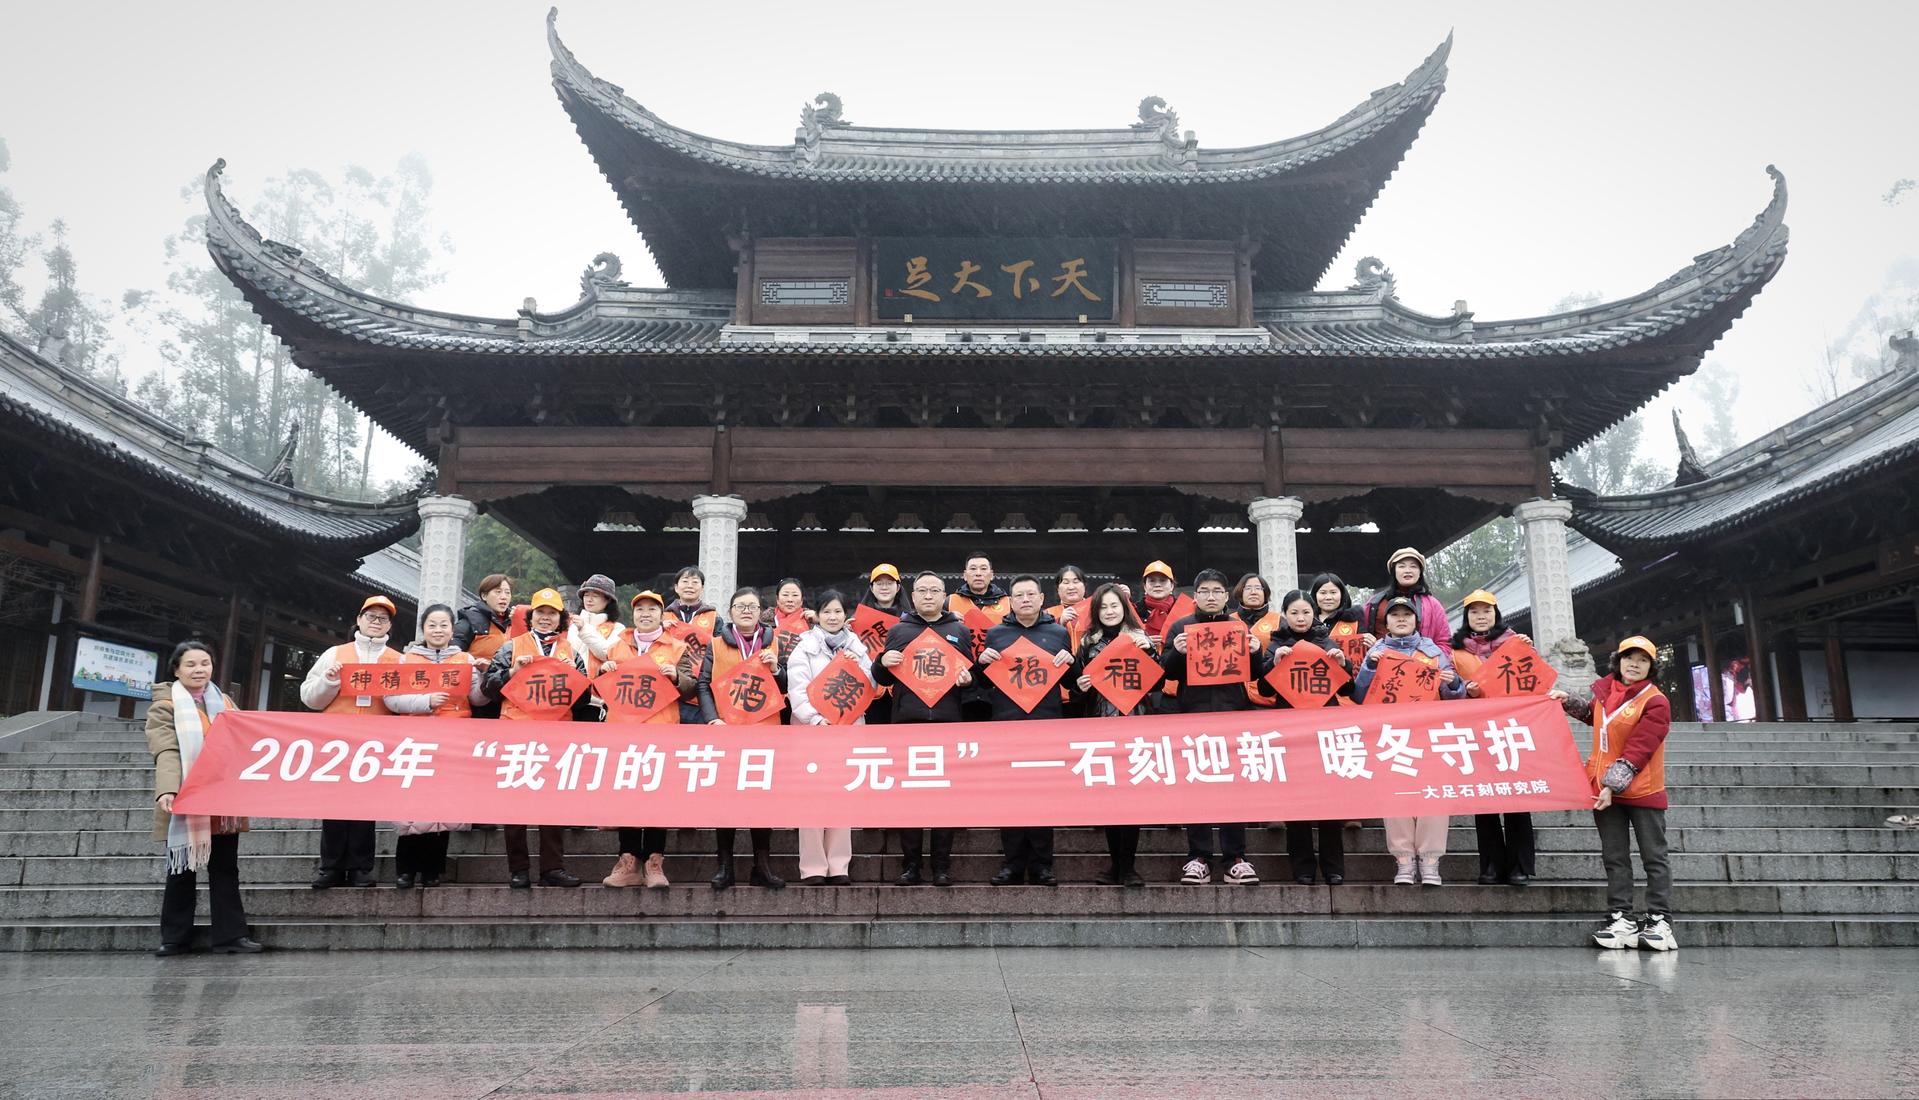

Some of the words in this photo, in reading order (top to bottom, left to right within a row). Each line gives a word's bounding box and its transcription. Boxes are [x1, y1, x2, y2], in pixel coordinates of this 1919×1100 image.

[898, 255, 1102, 302] 天下大足
[913, 648, 946, 678] 福
[1008, 656, 1048, 690] 福
[1103, 658, 1142, 691] 福
[1290, 657, 1332, 696] 福
[1497, 655, 1539, 694] 福
[526, 673, 573, 707] 福
[615, 674, 657, 709] 福
[730, 672, 767, 713] 福
[1316, 717, 1537, 780] 暖冬守护
